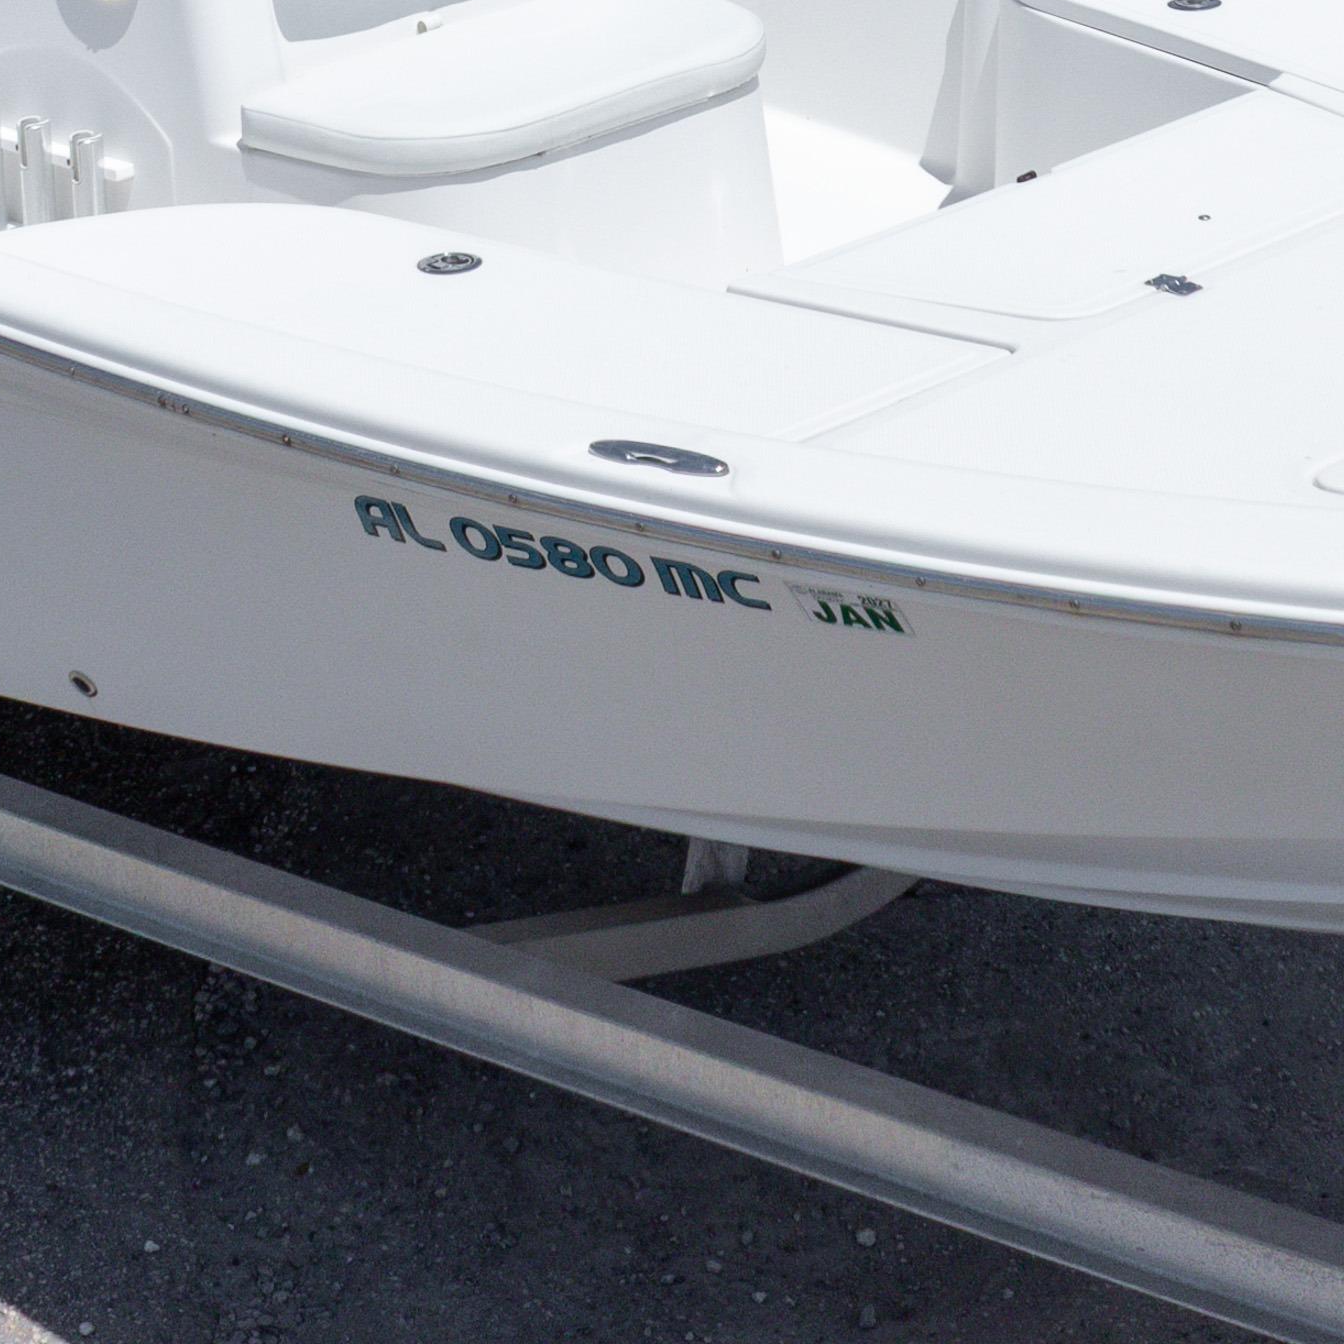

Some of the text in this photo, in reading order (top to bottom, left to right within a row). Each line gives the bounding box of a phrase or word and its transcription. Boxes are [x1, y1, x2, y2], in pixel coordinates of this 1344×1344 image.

[353, 494, 448, 552] AL
[449, 515, 646, 588] 0580
[812, 599, 905, 633] JAN
